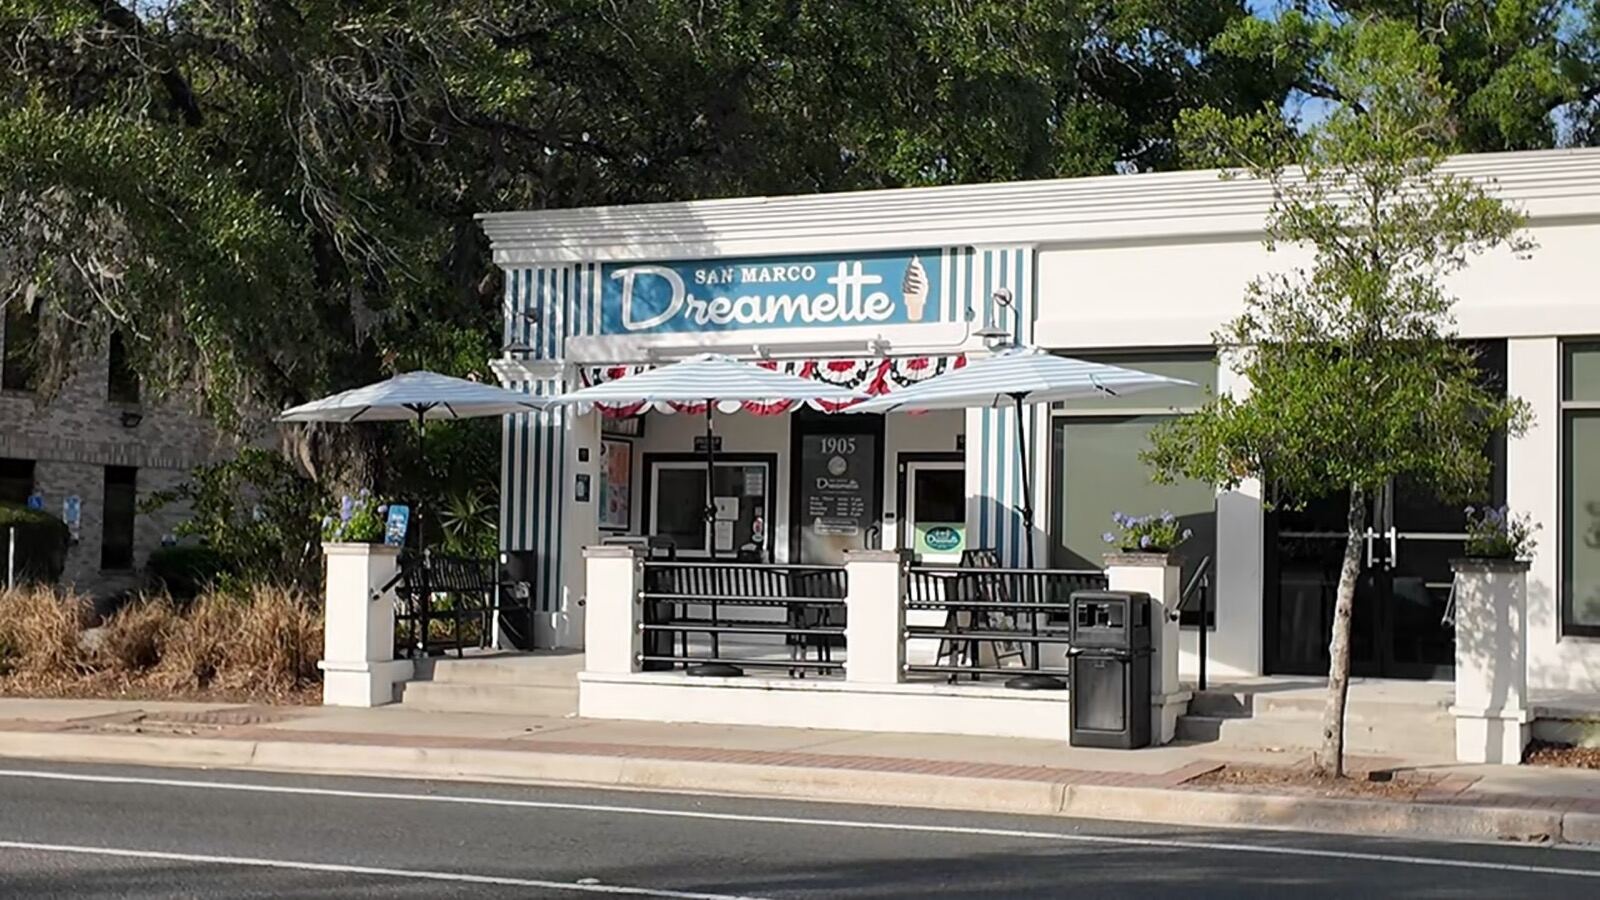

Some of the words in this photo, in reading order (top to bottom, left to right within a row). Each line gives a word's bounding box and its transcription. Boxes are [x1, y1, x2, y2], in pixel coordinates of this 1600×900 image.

[695, 268, 734, 285] SAN
[741, 265, 816, 283] MARCO
[610, 260, 895, 331] Dreamette
[821, 437, 856, 454] 1905
